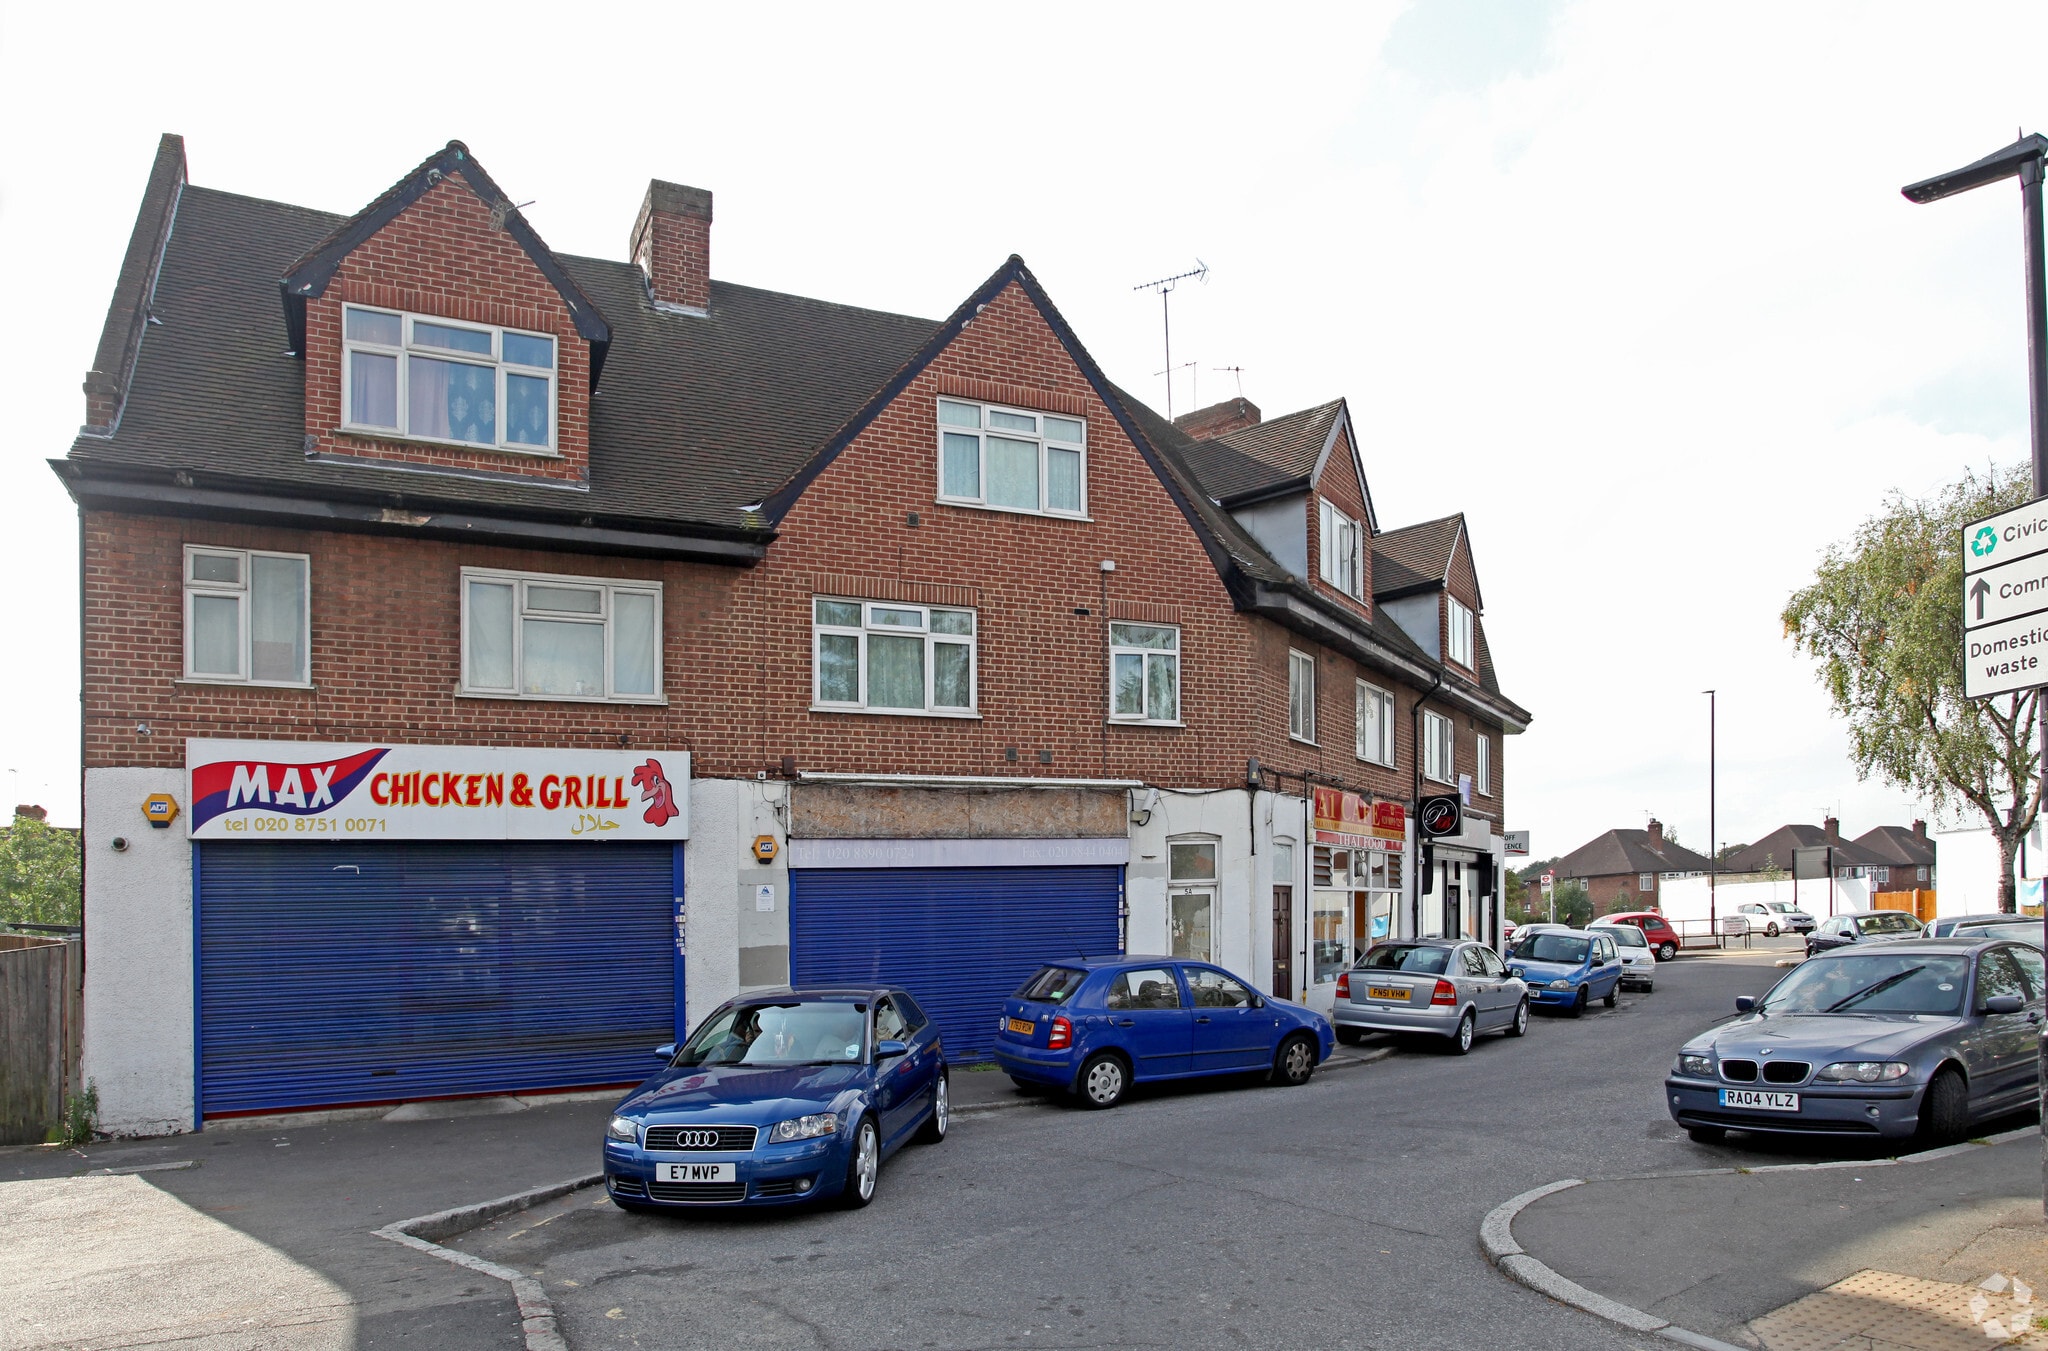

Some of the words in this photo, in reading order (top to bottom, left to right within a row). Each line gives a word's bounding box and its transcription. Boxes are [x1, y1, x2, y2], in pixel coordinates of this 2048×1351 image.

[2003, 518, 2048, 543] Civic
[1985, 656, 2038, 678] waste
[226, 764, 337, 809] MAX
[369, 769, 504, 808] CHICKEN
[539, 774, 631, 811] GRILL
[150, 803, 168, 812] ADT
[1316, 791, 1337, 819] A1
[224, 817, 248, 832] tel
[254, 817, 289, 832] 020
[294, 818, 337, 832] 8751
[344, 818, 387, 833] 0071
[570, 813, 620, 835] حلال
[760, 843, 773, 852] ADT
[1338, 833, 1361, 847] THAI
[1363, 837, 1386, 849] FOOD
[1504, 842, 1522, 850] CENCE
[827, 847, 850, 859] 020
[854, 847, 883, 859] 8890
[1048, 846, 1068, 858] 020
[1727, 1090, 1762, 1106] RA04
[1765, 1093, 1794, 1107] YLZ
[670, 1165, 688, 1180] E7
[692, 1165, 719, 1180] MVP
